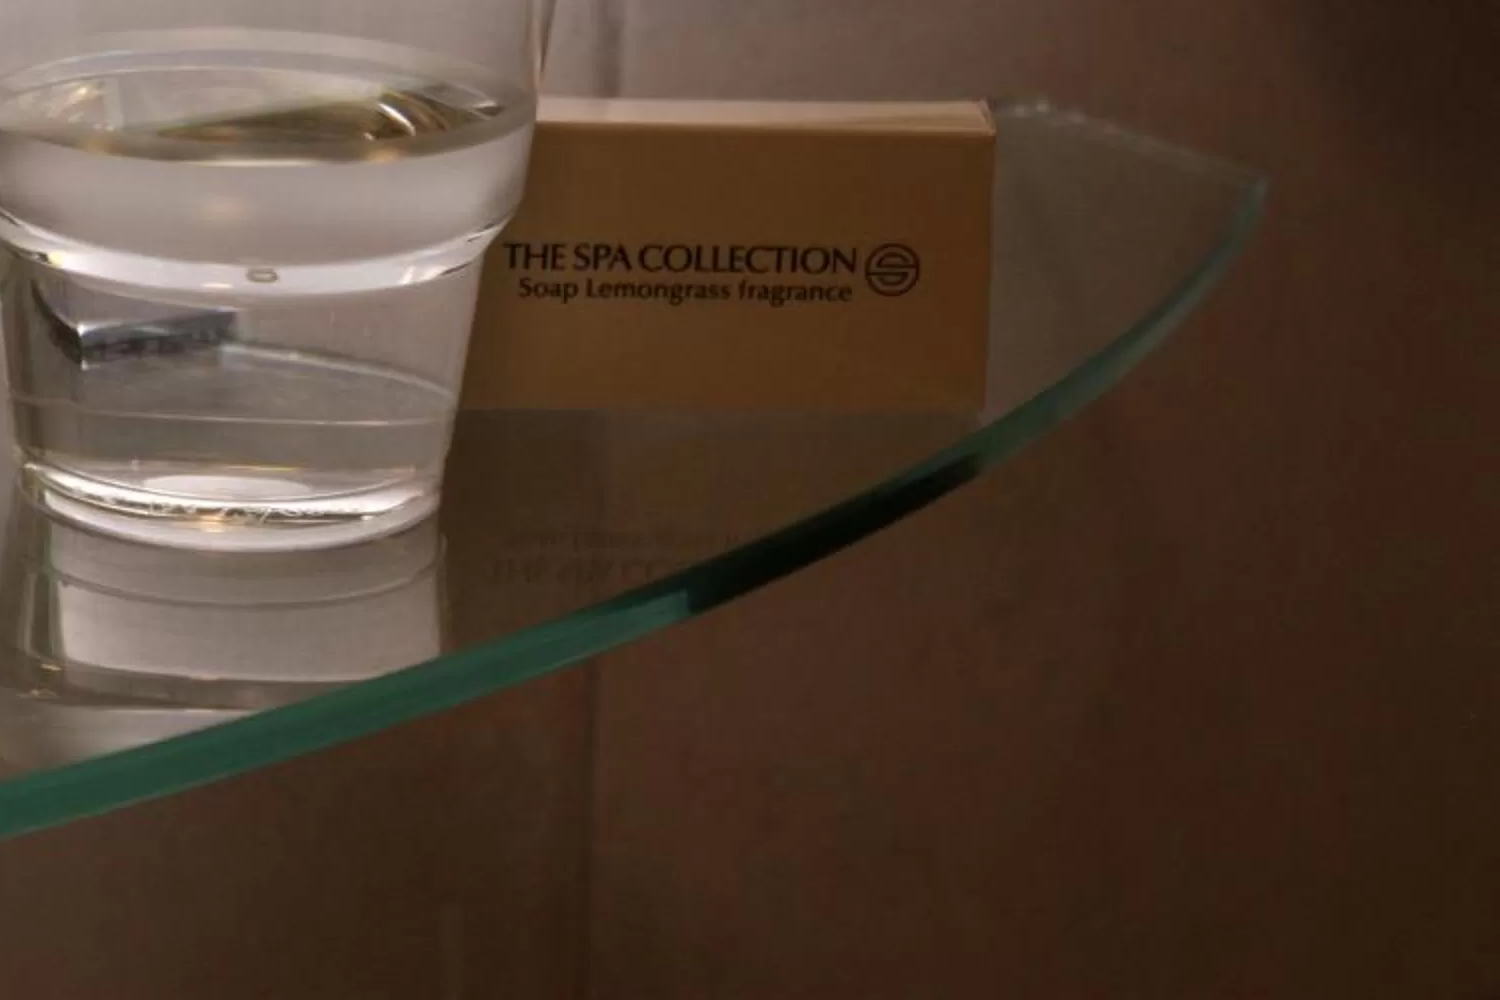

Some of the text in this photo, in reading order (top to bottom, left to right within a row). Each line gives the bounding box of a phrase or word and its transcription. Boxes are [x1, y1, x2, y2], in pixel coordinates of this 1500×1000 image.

[503, 242, 858, 275] THE SPA COLLECTION
[518, 277, 853, 308] Soap Lemongrass fragrance
